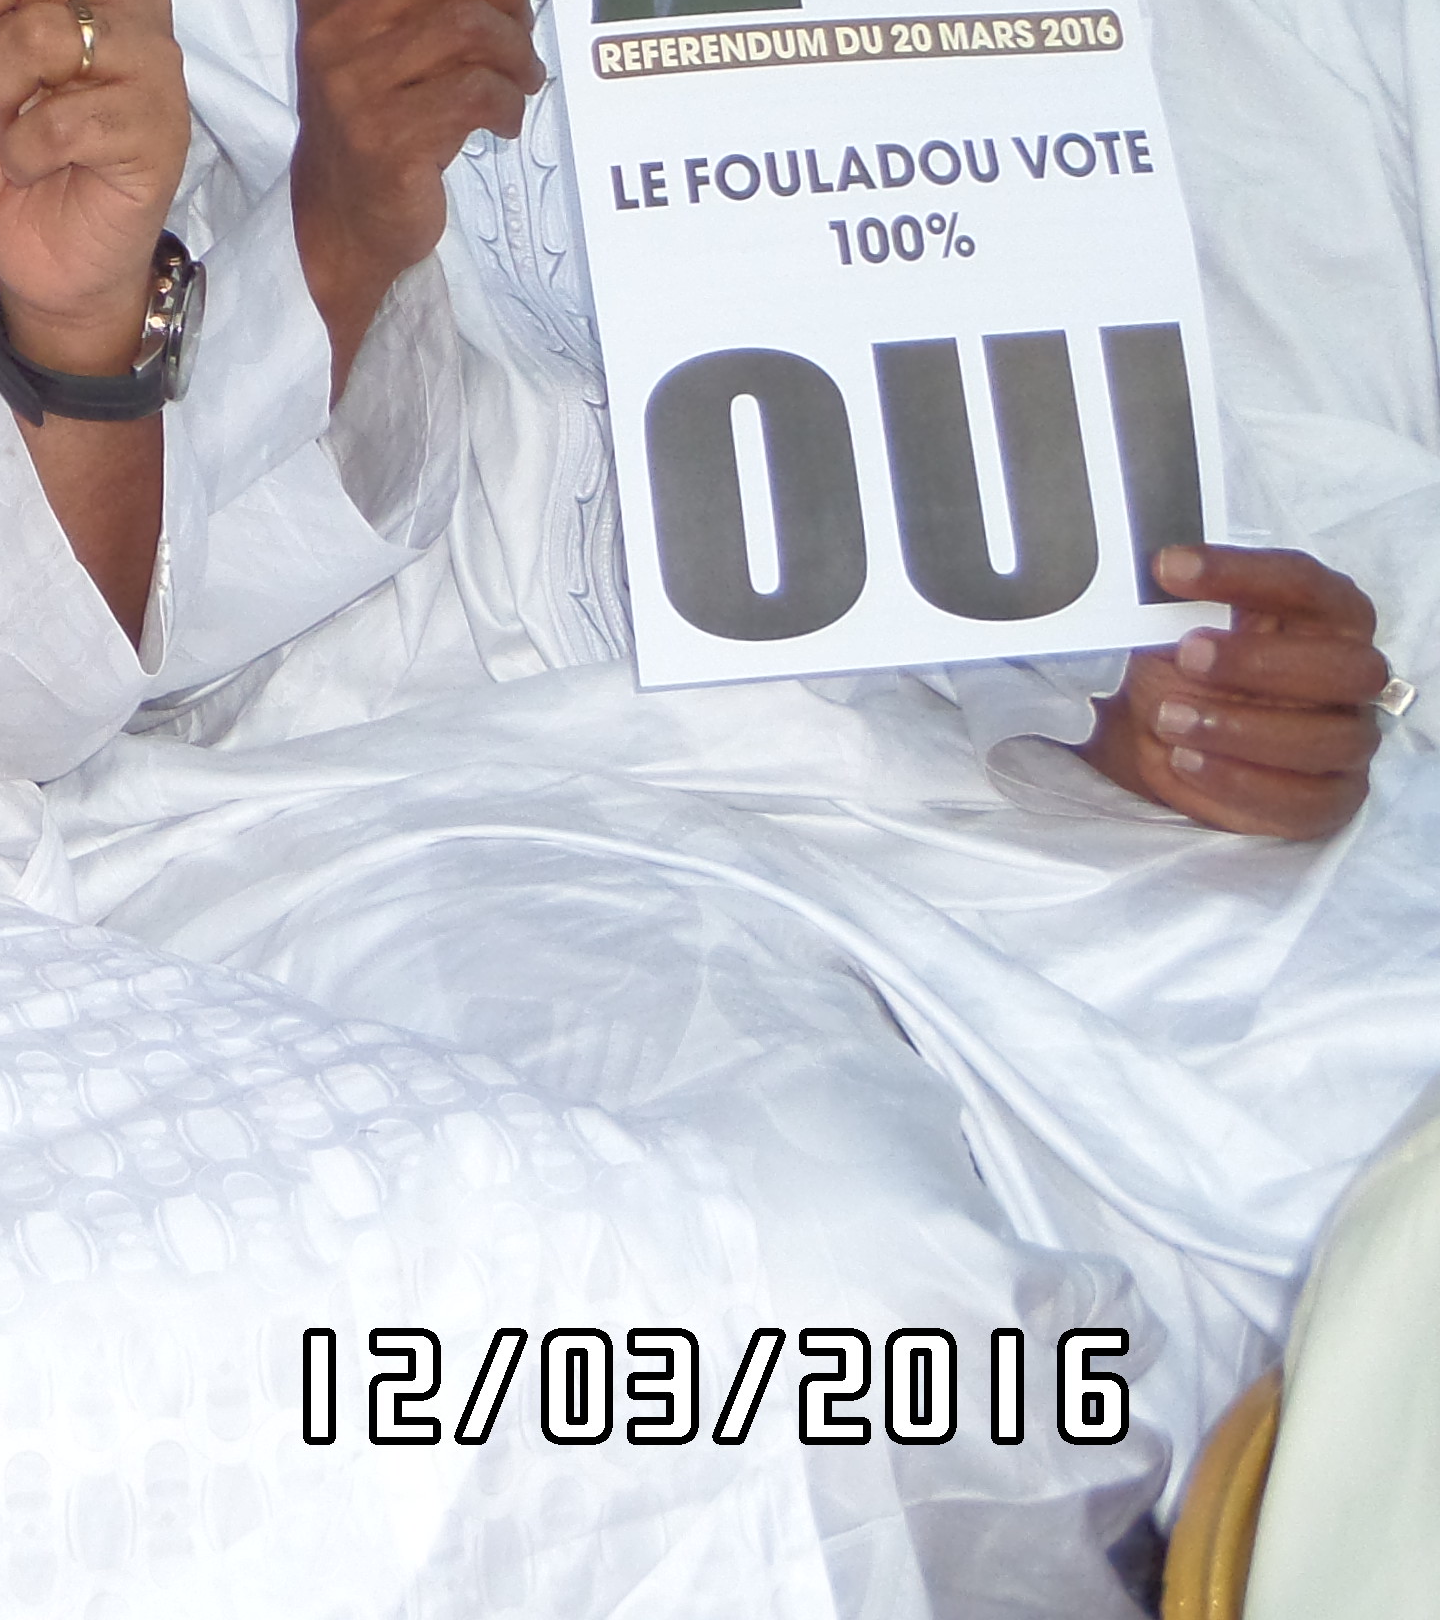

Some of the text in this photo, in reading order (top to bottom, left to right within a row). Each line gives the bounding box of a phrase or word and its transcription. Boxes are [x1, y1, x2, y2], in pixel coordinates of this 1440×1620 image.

[599, 17, 1117, 73] REFERENDUM DU 20 MARS 2016
[611, 131, 1153, 210] LE FOULADOU VOTE
[830, 213, 975, 264] 100%
[646, 321, 1205, 641] OUI
